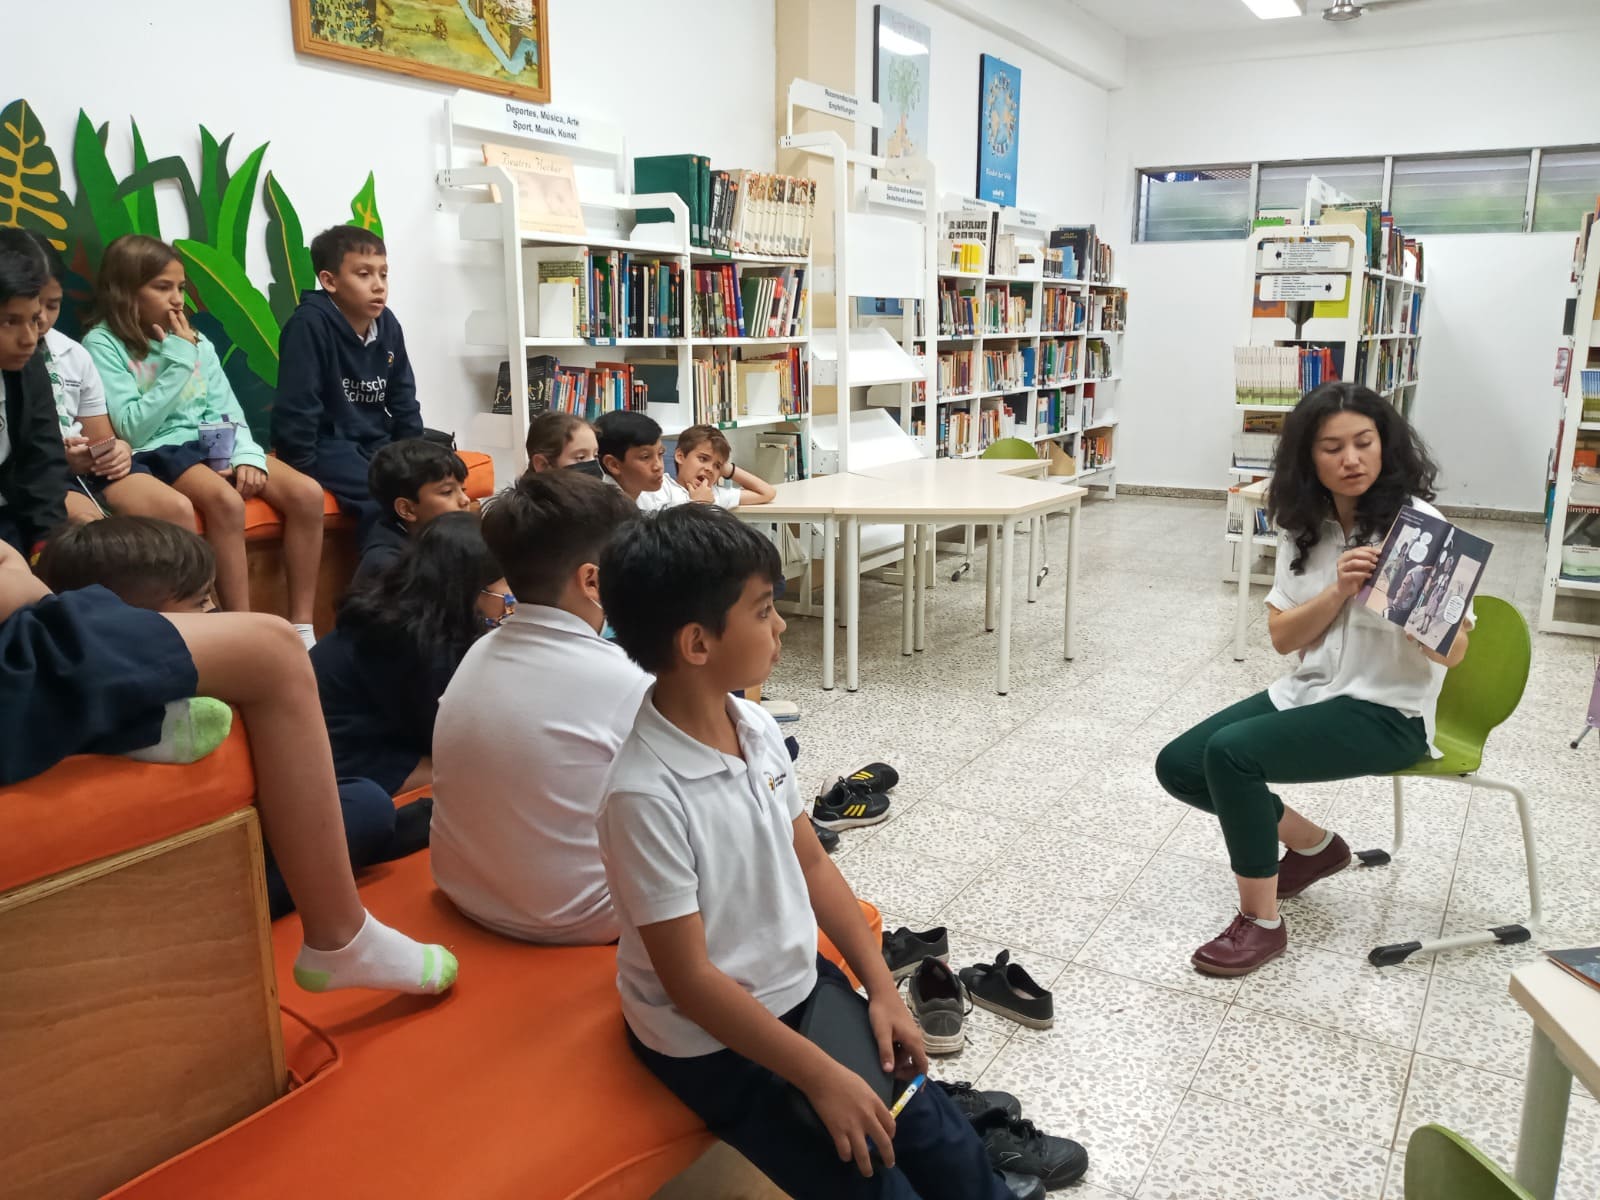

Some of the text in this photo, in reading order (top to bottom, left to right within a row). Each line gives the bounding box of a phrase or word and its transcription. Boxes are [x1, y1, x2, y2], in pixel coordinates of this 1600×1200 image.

[506, 104, 579, 126] Deportes, Música, Arte
[512, 119, 577, 140] Sport, Musik, Kunst
[344, 389, 385, 403] Schule
